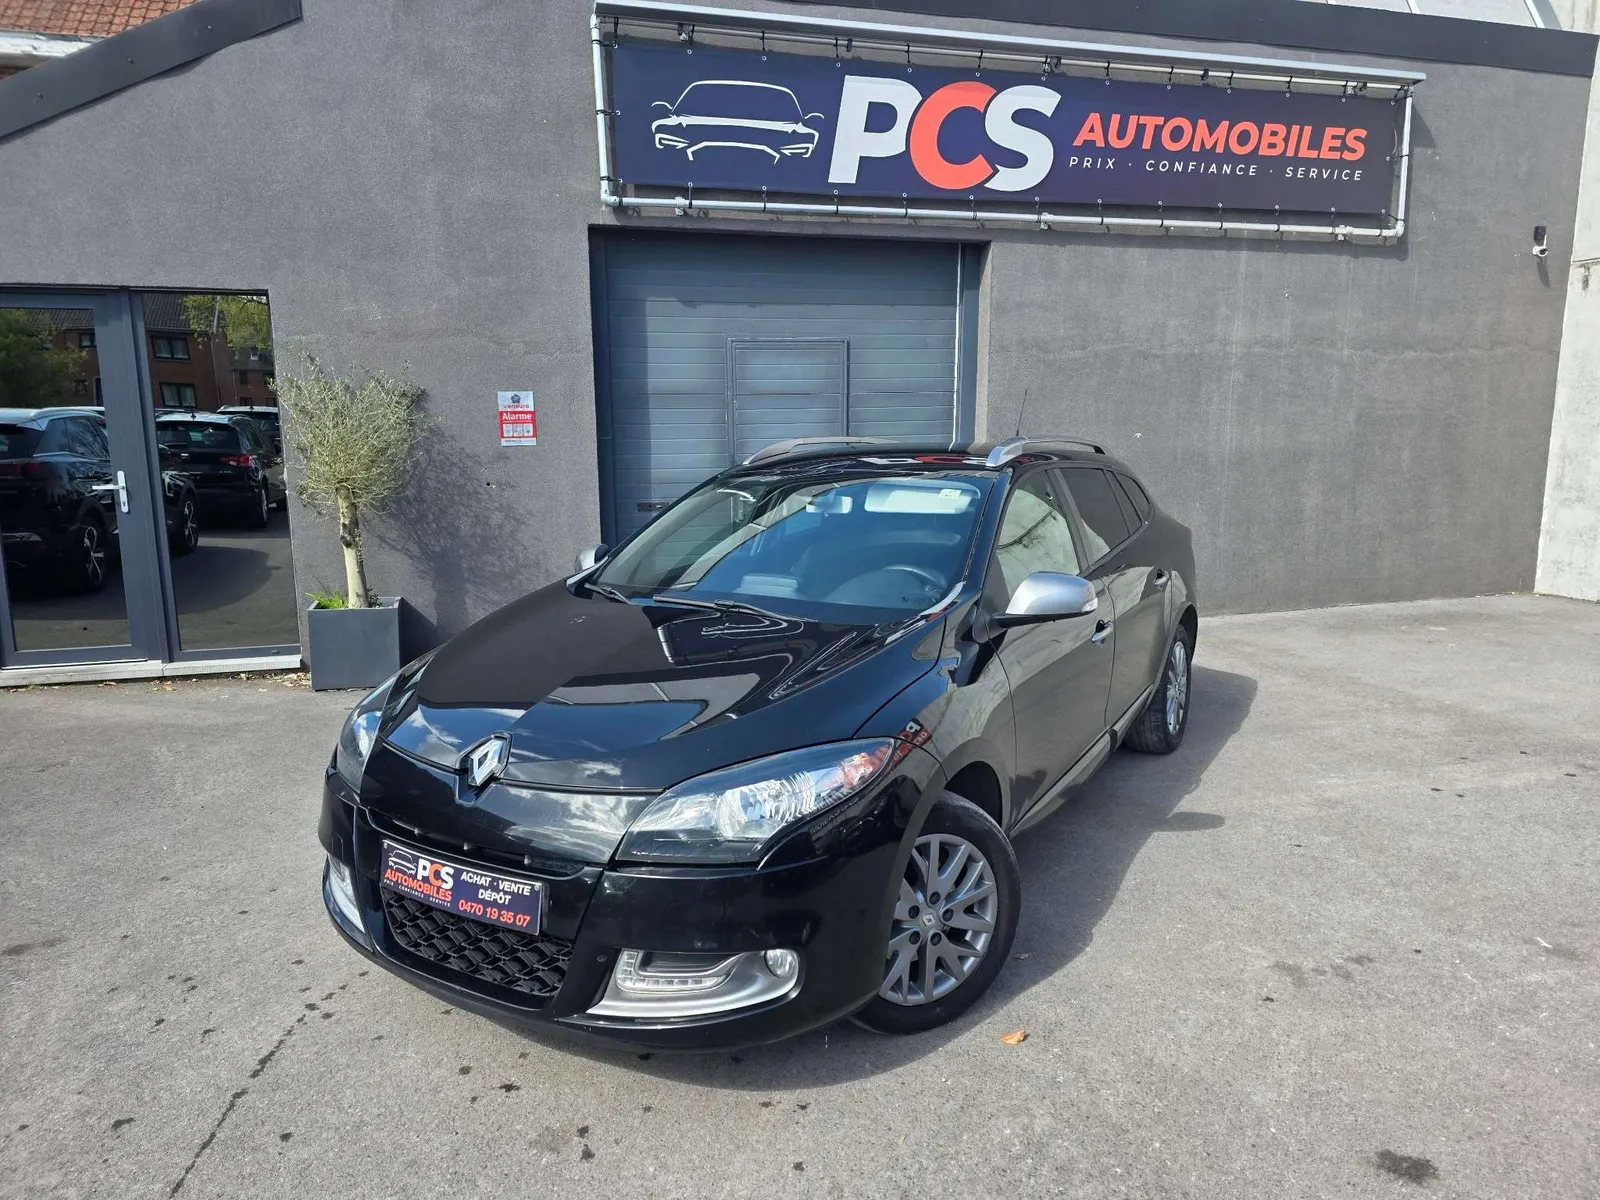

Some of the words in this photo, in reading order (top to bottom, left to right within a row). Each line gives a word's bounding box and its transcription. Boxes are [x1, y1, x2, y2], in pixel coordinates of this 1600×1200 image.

[828, 74, 1061, 191] PCS
[1072, 112, 1367, 161] AUTOMOBILES
[1069, 156, 1116, 170] PRIX
[1145, 160, 1258, 176] CONFIANCE
[1285, 166, 1363, 181] SERVICE
[502, 412, 532, 420] Alarme
[384, 868, 452, 901] AUTOMOBILES
[416, 858, 454, 889] PCS
[460, 871, 491, 887] ACHAT
[498, 880, 532, 896] VENTE
[478, 888, 511, 905] DÉPÔT
[458, 899, 483, 915] 0470
[486, 907, 498, 919] 19
[499, 910, 514, 923] 35
[515, 914, 531, 927] 07
